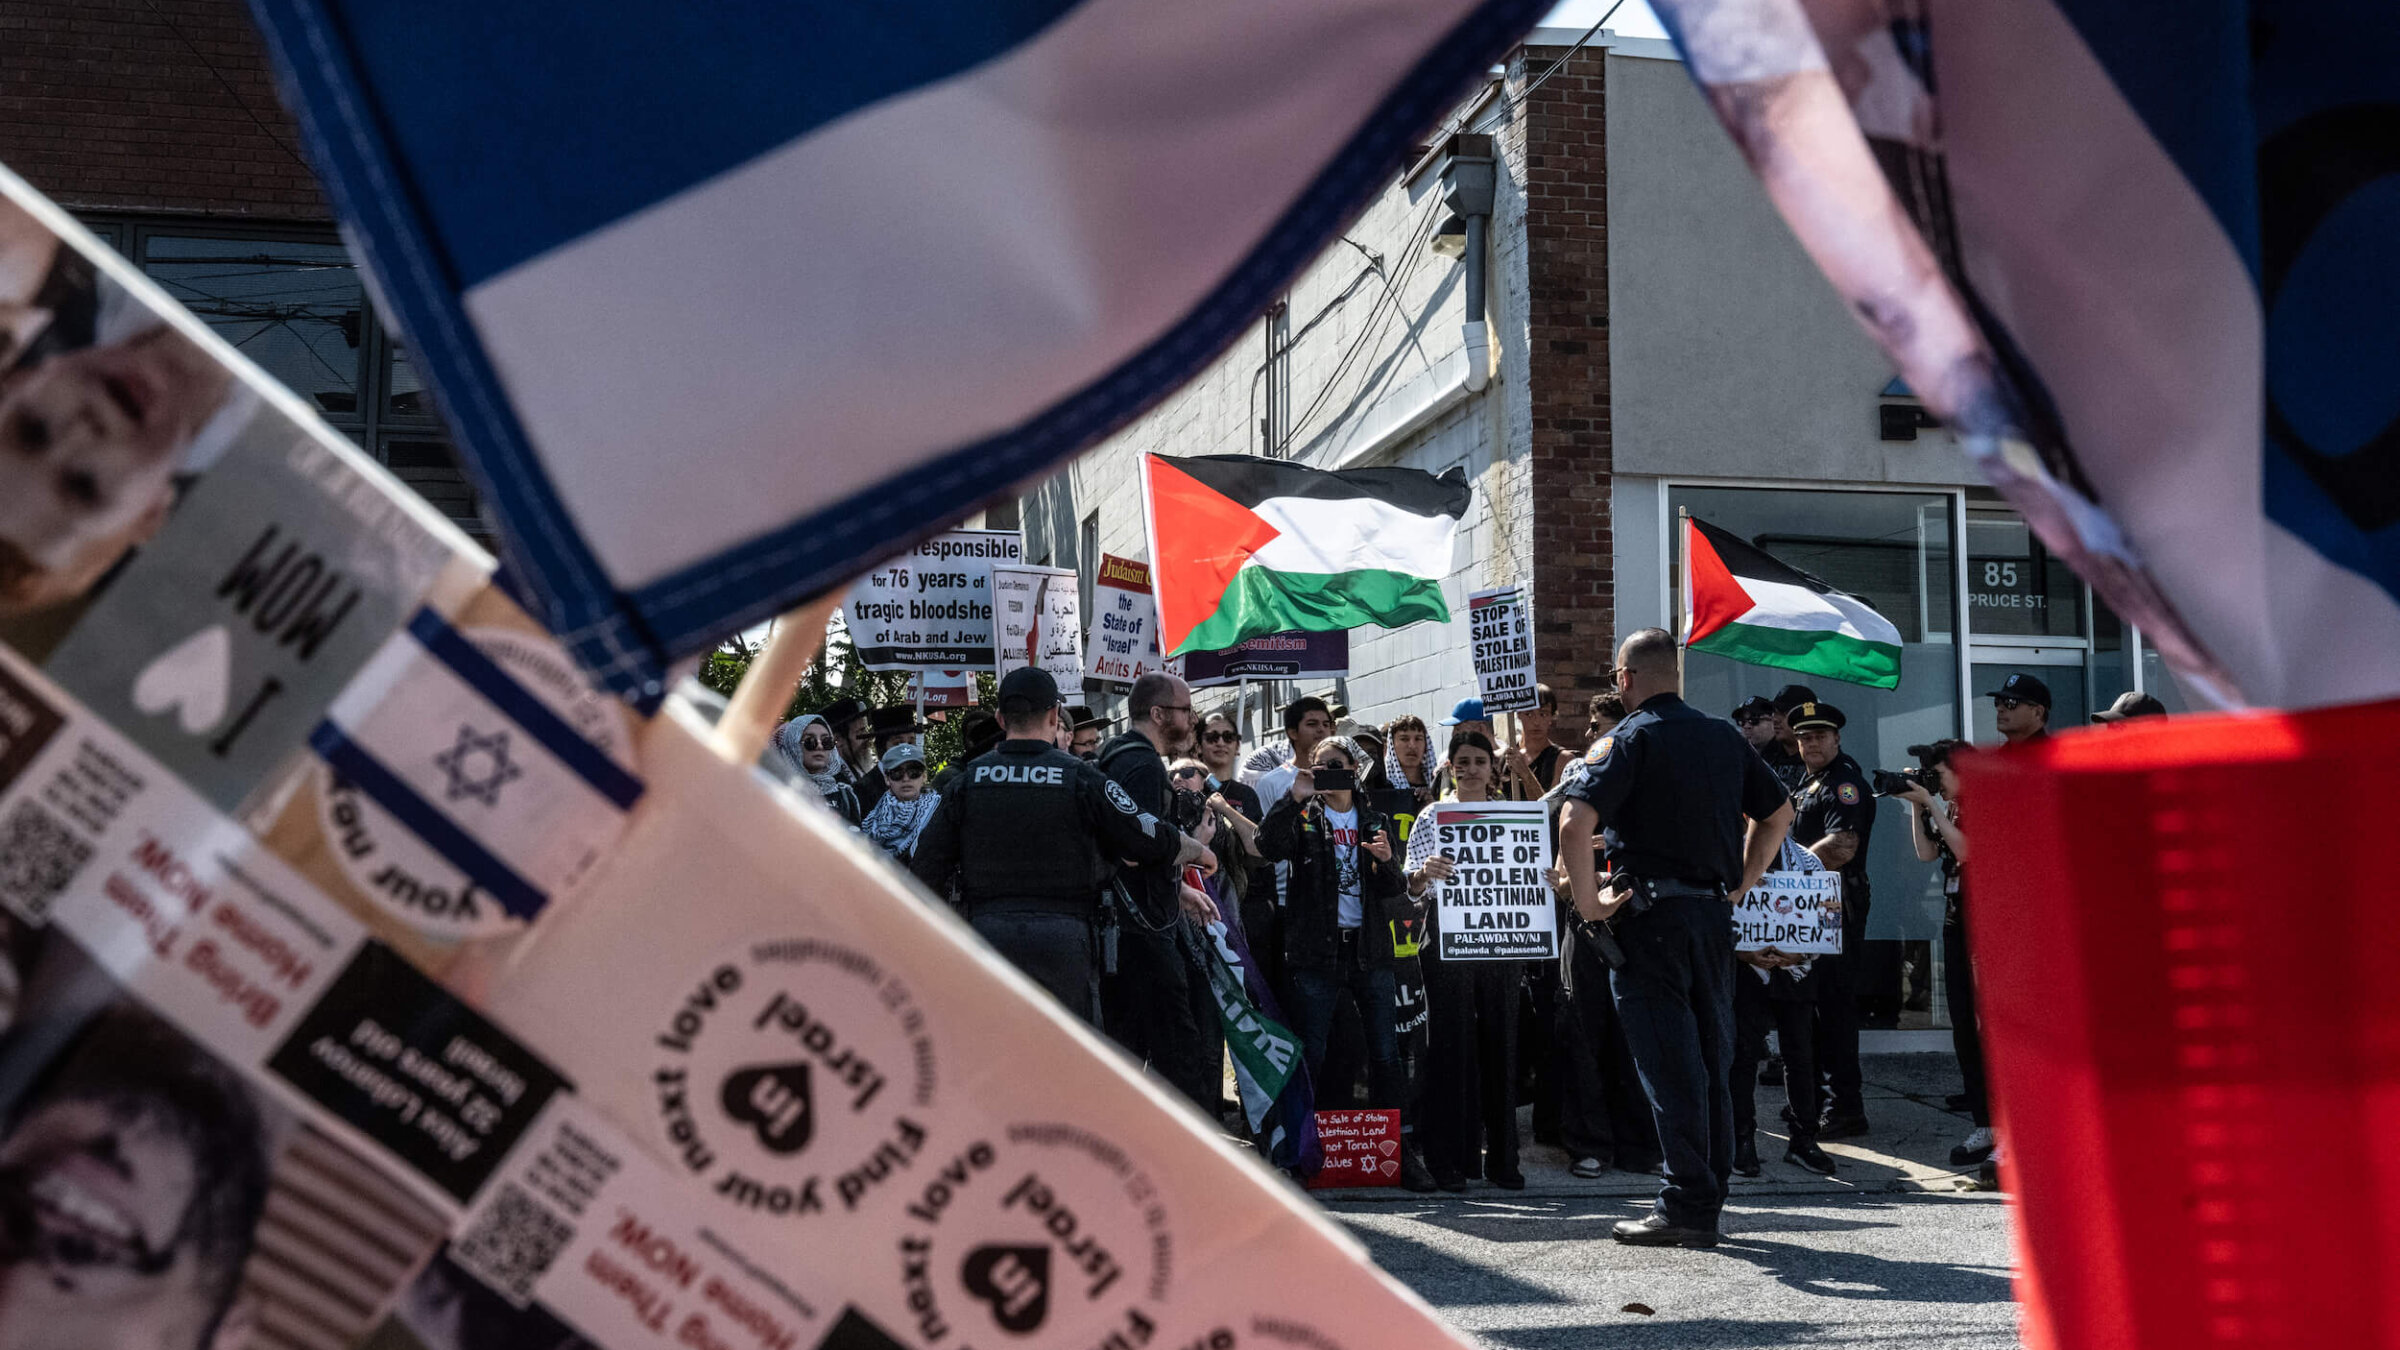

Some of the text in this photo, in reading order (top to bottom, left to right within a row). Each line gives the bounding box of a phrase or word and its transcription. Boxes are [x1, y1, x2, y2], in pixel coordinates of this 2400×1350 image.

[913, 538, 1019, 561] responsible
[872, 568, 985, 593] for 76 years of
[1103, 557, 1145, 584] Judaism
[1984, 562, 2018, 587] 85
[855, 600, 904, 623] tragic
[910, 599, 993, 620] bloodshe
[1119, 593, 1132, 611] the
[1968, 593, 2047, 608] PRUCE ST.
[1103, 612, 1143, 634] State of
[1471, 604, 1524, 624] STOP THE
[875, 630, 987, 644] of Arab and Jew
[1472, 618, 1526, 641] SALE OF
[895, 651, 967, 662] www.NKUSA.org
[1219, 636, 1307, 656] semitism
[1476, 636, 1528, 658] STOLEN
[1475, 652, 1531, 675] PALESTINIAN
[1487, 673, 1526, 691] LAND
[974, 765, 1063, 784] POLICE
[1439, 825, 1540, 843] STOP THE
[1440, 846, 1540, 864] SALE OF
[1444, 868, 1538, 886] STOLEN
[1773, 877, 1829, 891] ISRAEL
[370, 866, 481, 921] your
[1443, 887, 1546, 907] PALESTINIAN
[1795, 893, 1822, 911] ON
[104, 872, 179, 960] Them
[1464, 912, 1530, 929] LAND
[213, 902, 313, 990] Home
[1454, 933, 1540, 945] PAL-AWDA NY/NJ
[1447, 945, 1548, 956] @palawda @palassembly
[184, 937, 281, 1029] Bring
[657, 964, 743, 1052] love
[754, 990, 887, 1112] Israel
[750, 1074, 802, 1138] in
[655, 1066, 715, 1173] next
[1353, 1113, 1364, 1123] of
[1365, 1113, 1389, 1123] Stolen
[1317, 1124, 1386, 1138] alestinian Land
[1325, 1138, 1377, 1152] not Torah
[836, 1117, 927, 1211] Find
[714, 1171, 825, 1214] your
[906, 1140, 995, 1224] love
[1001, 1172, 1122, 1300] Israel
[899, 1236, 948, 1343] next
[989, 1250, 1041, 1317] in
